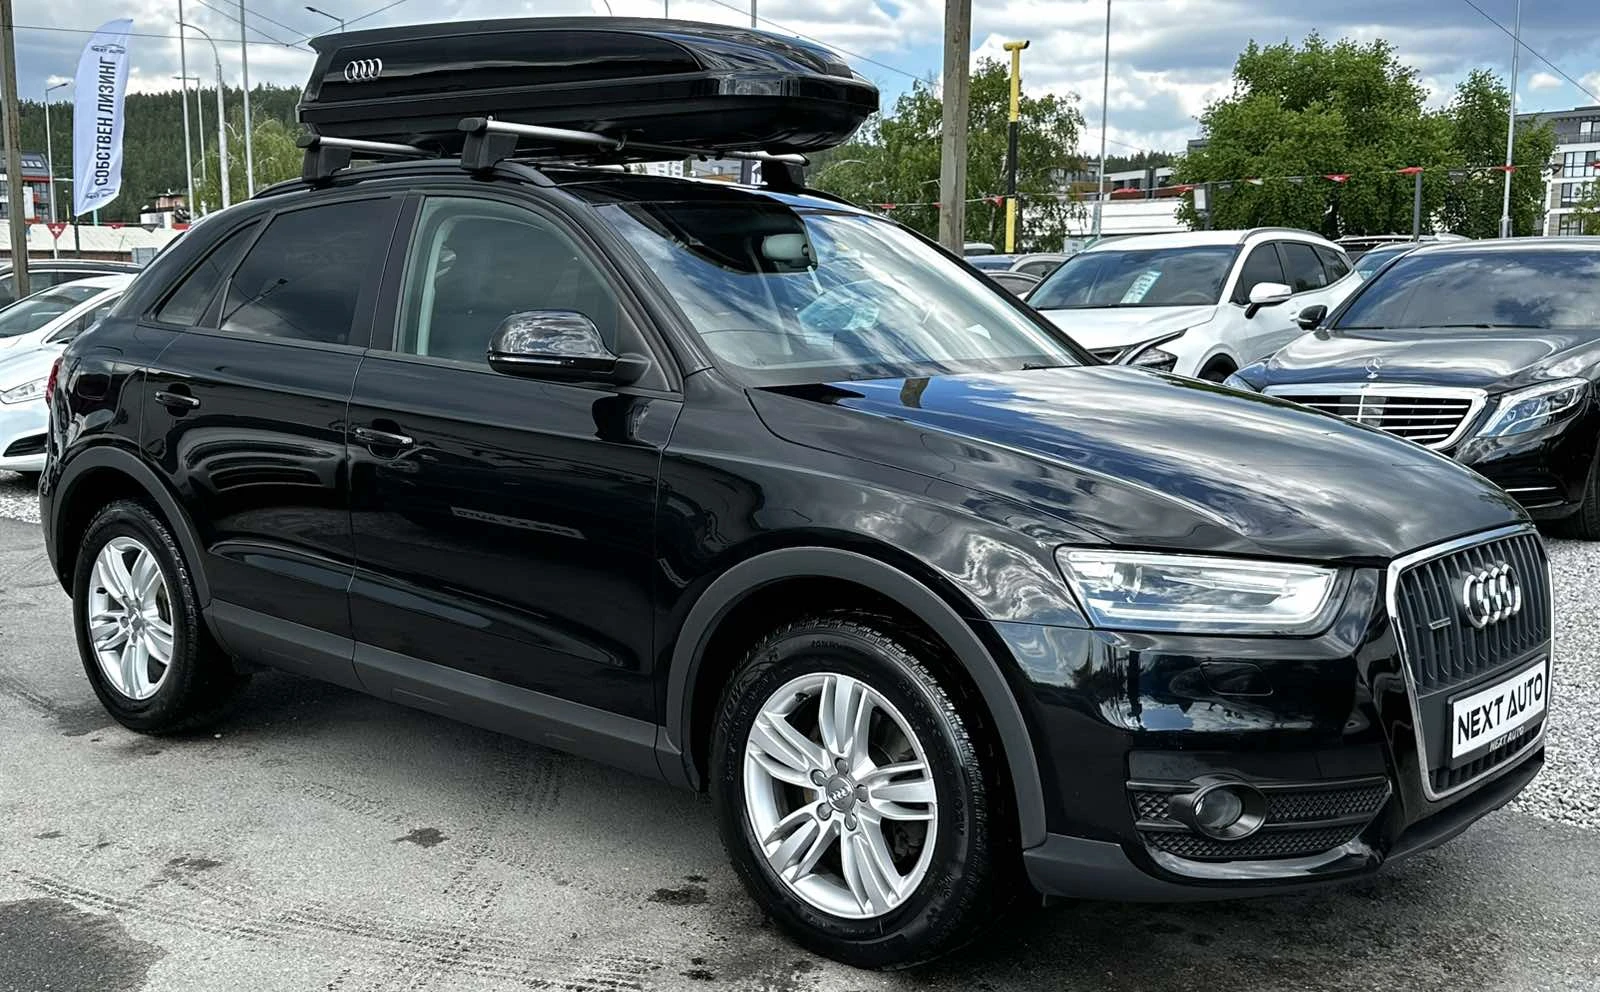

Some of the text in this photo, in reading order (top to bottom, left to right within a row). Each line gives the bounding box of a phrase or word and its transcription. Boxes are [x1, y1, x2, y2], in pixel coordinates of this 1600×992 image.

[97, 56, 116, 115] ЛИЗИНГ
[95, 117, 113, 186] СОБСТВЕН
[1458, 672, 1543, 745] NEXT AUTO
